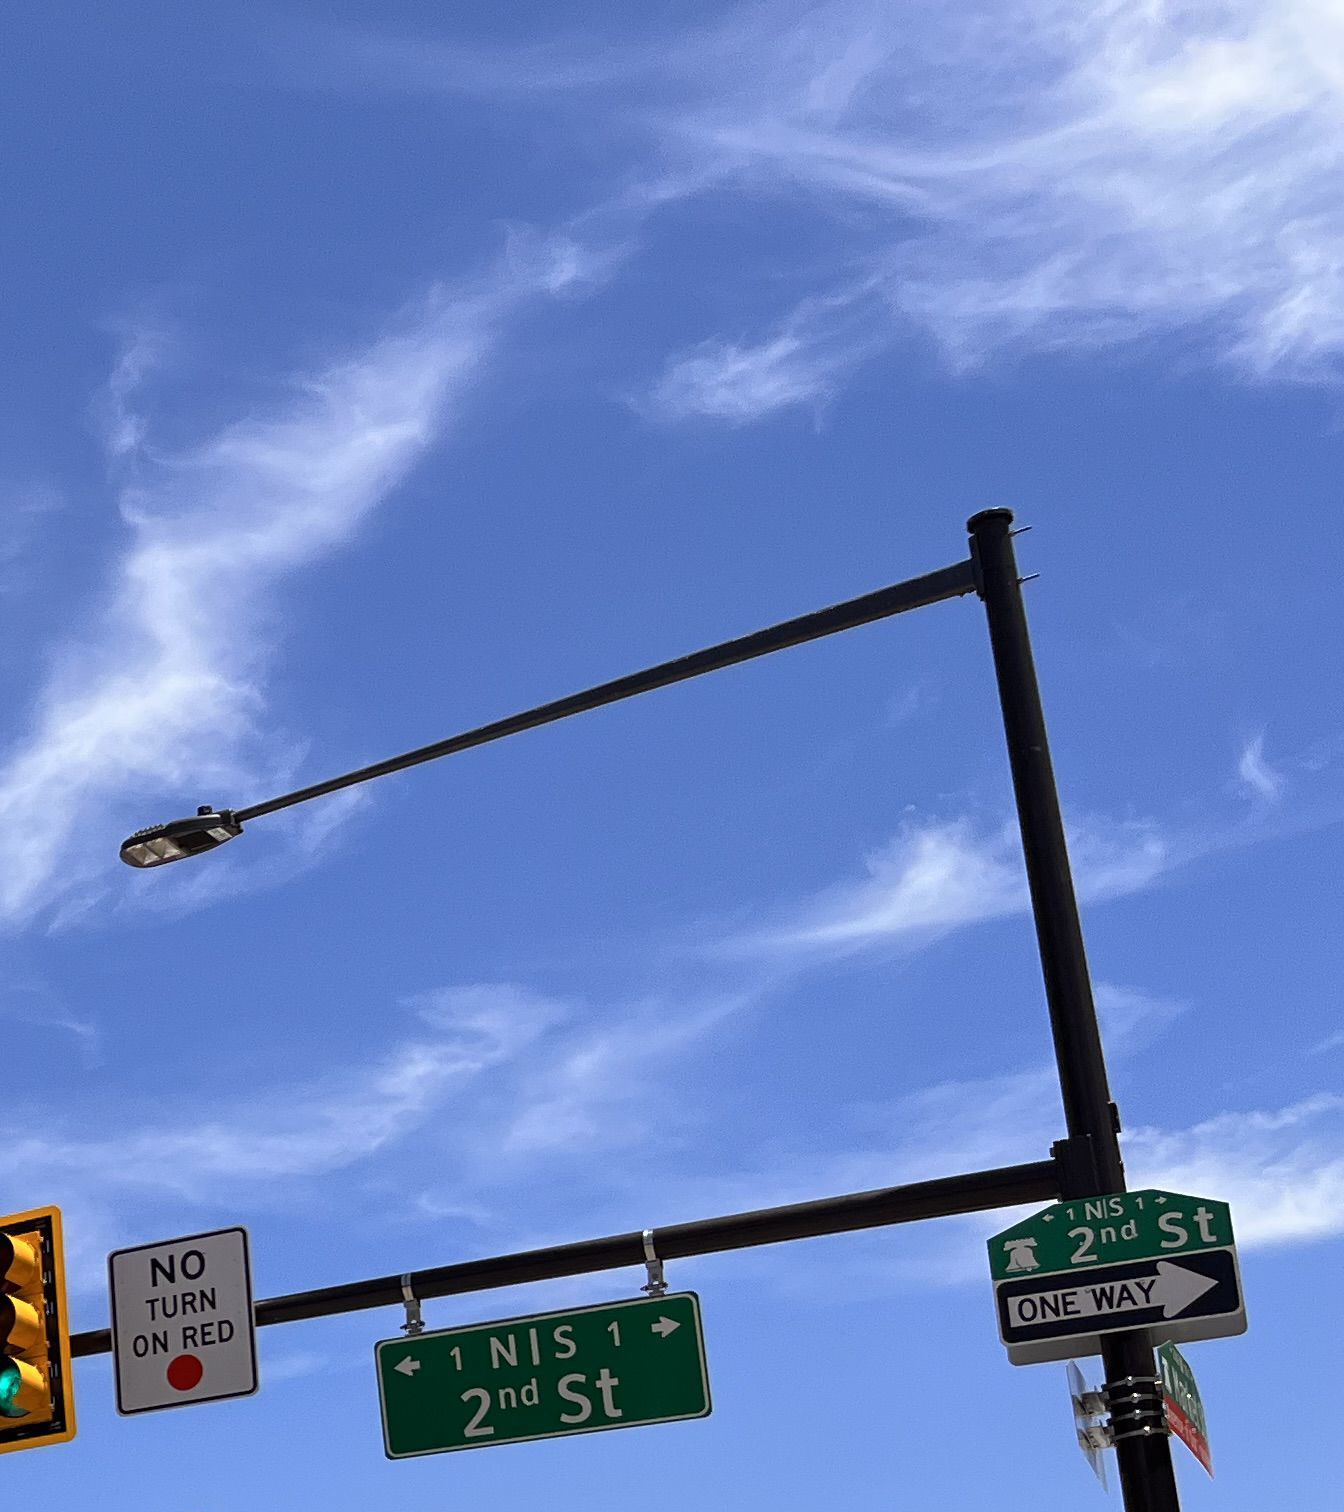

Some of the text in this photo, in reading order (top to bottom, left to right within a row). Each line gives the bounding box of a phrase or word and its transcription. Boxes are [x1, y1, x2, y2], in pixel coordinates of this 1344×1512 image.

[1065, 1207, 1076, 1221] 1
[1135, 1196, 1144, 1210] 1
[1067, 1206, 1217, 1264] 2nd St
[150, 1250, 205, 1287] NO
[145, 1287, 216, 1321] TURN
[1018, 1279, 1156, 1322] ONE WAY
[132, 1320, 234, 1358] ON RED
[449, 1346, 463, 1371] 1
[607, 1321, 621, 1347] 1
[461, 1368, 623, 1438] 2nd St
